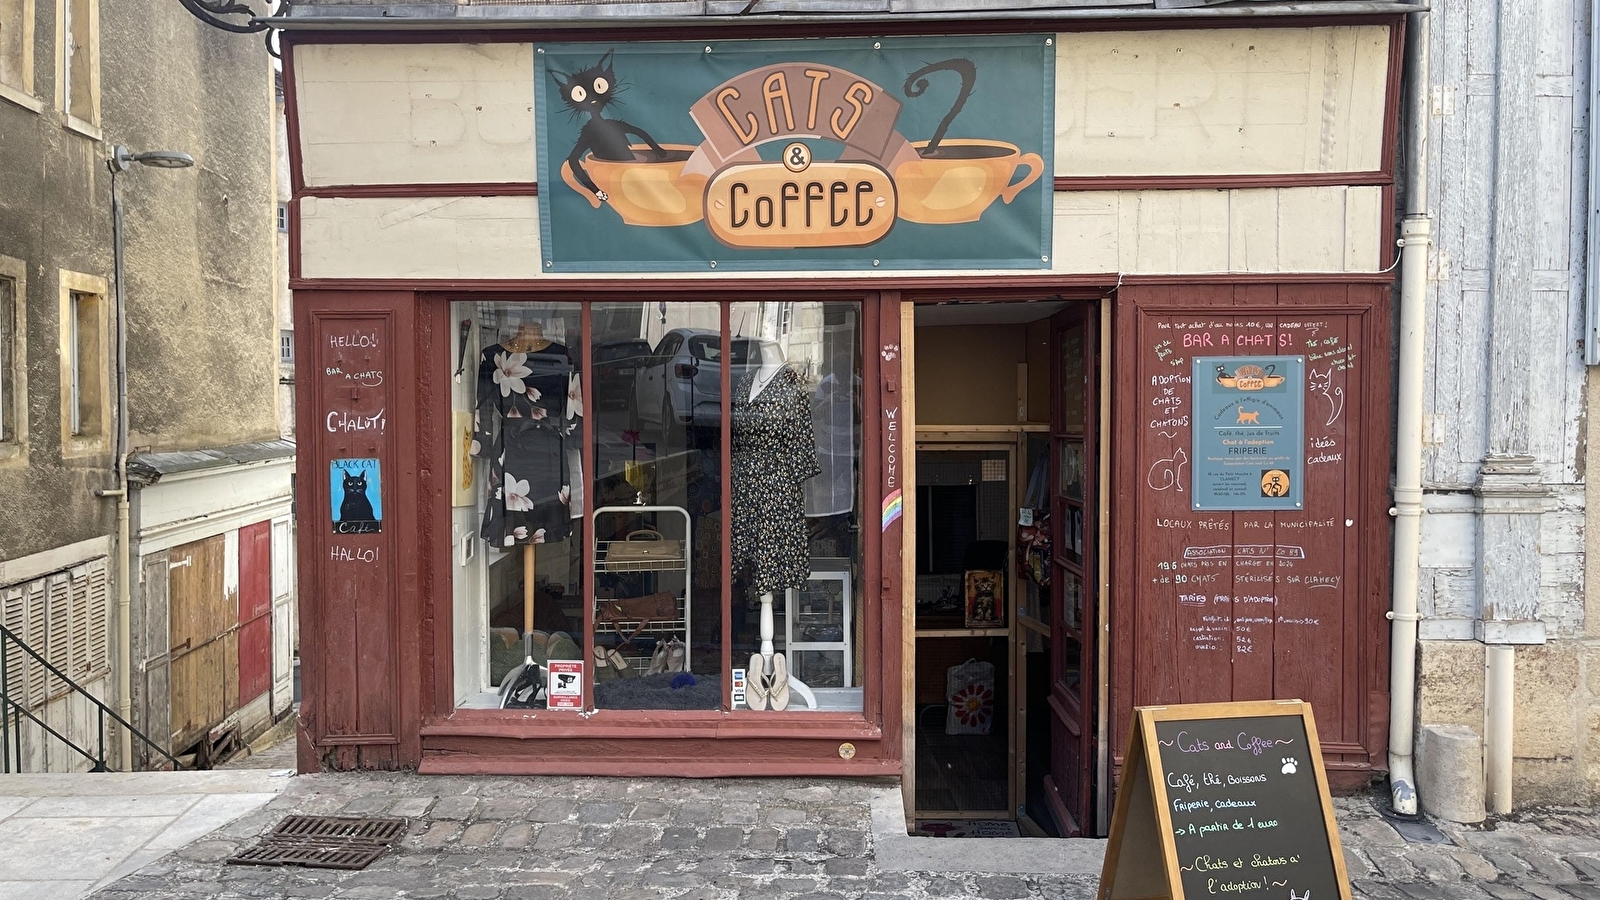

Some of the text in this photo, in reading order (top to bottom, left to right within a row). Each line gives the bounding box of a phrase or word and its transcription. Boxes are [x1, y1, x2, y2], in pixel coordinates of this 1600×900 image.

[715, 69, 873, 145] CATS
[789, 147, 806, 166] &
[730, 181, 874, 228] Coffee
[330, 335, 378, 348] HELLO!
[1183, 332, 1214, 348] BAR
[1222, 334, 1230, 346] A
[326, 367, 343, 376] BAR
[354, 371, 383, 386] CHATS
[1163, 388, 1174, 396] DE
[1152, 396, 1182, 406] CHATS
[1164, 406, 1178, 414] ET
[326, 408, 386, 435] CHALUT!
[1150, 415, 1188, 428] CHATONS
[886, 407, 898, 488] WELCOME
[1310, 436, 1336, 448] idées
[332, 460, 376, 469] BLACK CAT
[1307, 452, 1342, 464] cadeaux
[1156, 518, 1192, 528] LOCAUX
[1199, 518, 1230, 530] PRÊTÉS
[1280, 518, 1334, 528] MUNICIPALITÉ
[1187, 548, 1226, 556] ASSOCIATION
[1160, 574, 1170, 583] de
[1175, 574, 1187, 583] 90
[1191, 573, 1219, 586] CHATS
[1304, 575, 1341, 588] CLAMECY
[1177, 730, 1274, 755] Cats and Coffee
[1168, 772, 1200, 793] Café,
[1203, 772, 1226, 788] thé,
[1215, 799, 1256, 808] cadeaux
[1188, 824, 1196, 835] A
[1233, 820, 1244, 830] de
[1195, 854, 1228, 872] Chats
[1233, 858, 1243, 868] et
[1251, 854, 1287, 868] chatons
